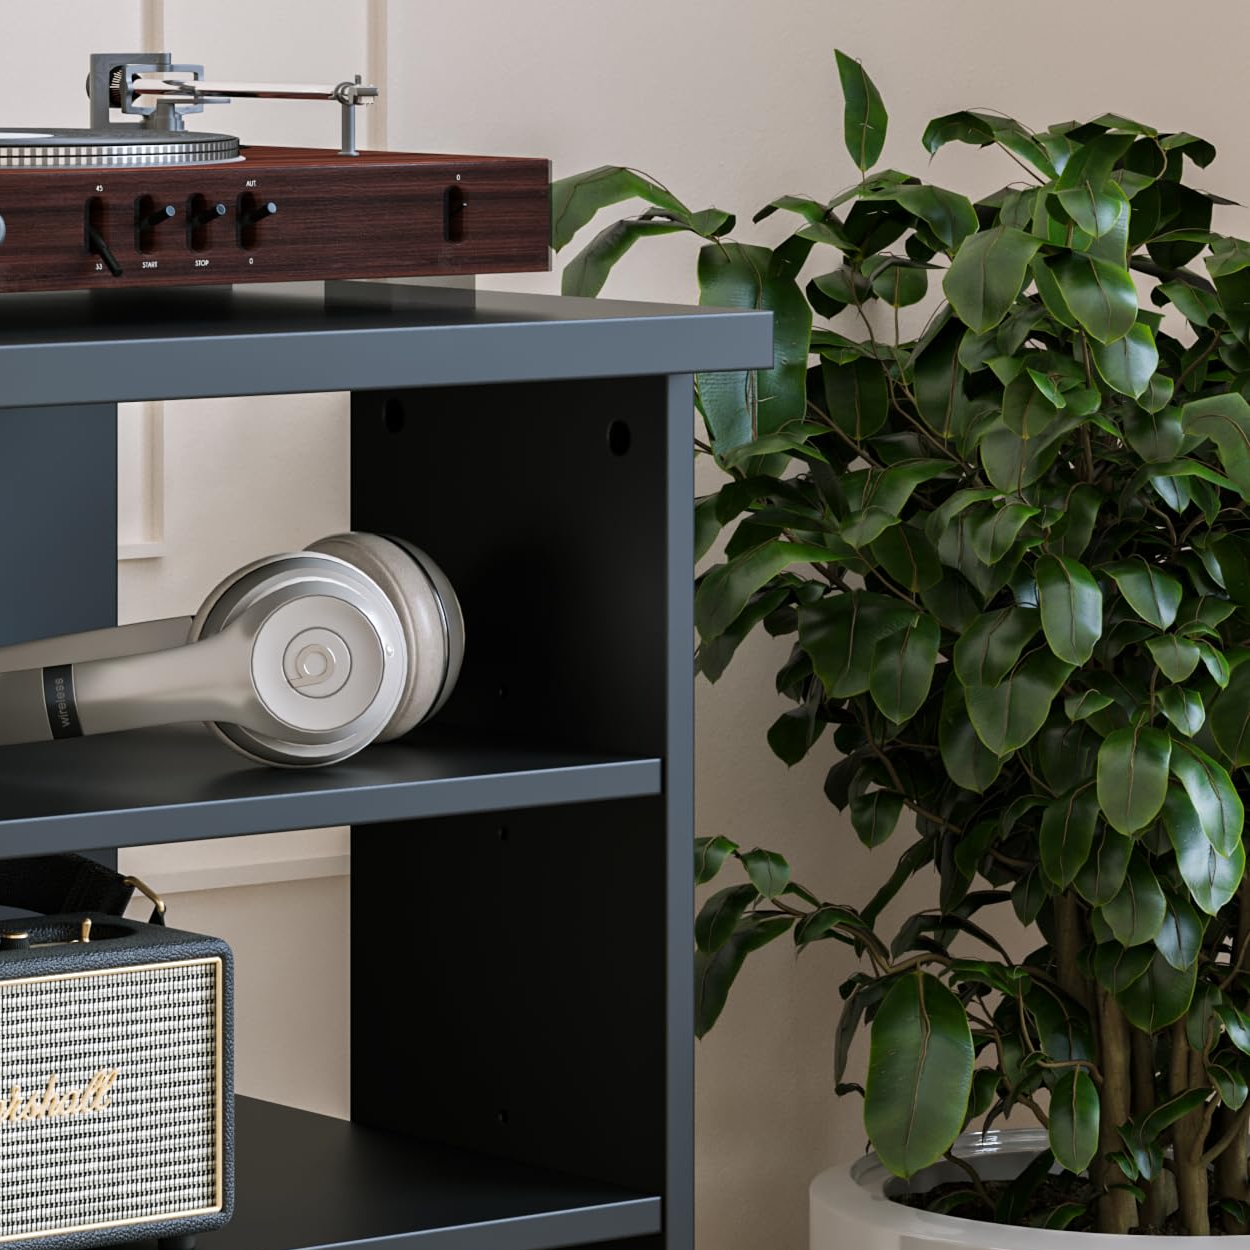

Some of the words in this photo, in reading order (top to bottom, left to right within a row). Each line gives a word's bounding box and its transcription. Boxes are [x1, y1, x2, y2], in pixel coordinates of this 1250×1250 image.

[95, 185, 104, 193] 45
[95, 263, 103, 271] 33
[141, 260, 158, 269] START
[194, 259, 210, 268] STOP
[55, 677, 71, 728] wireless
